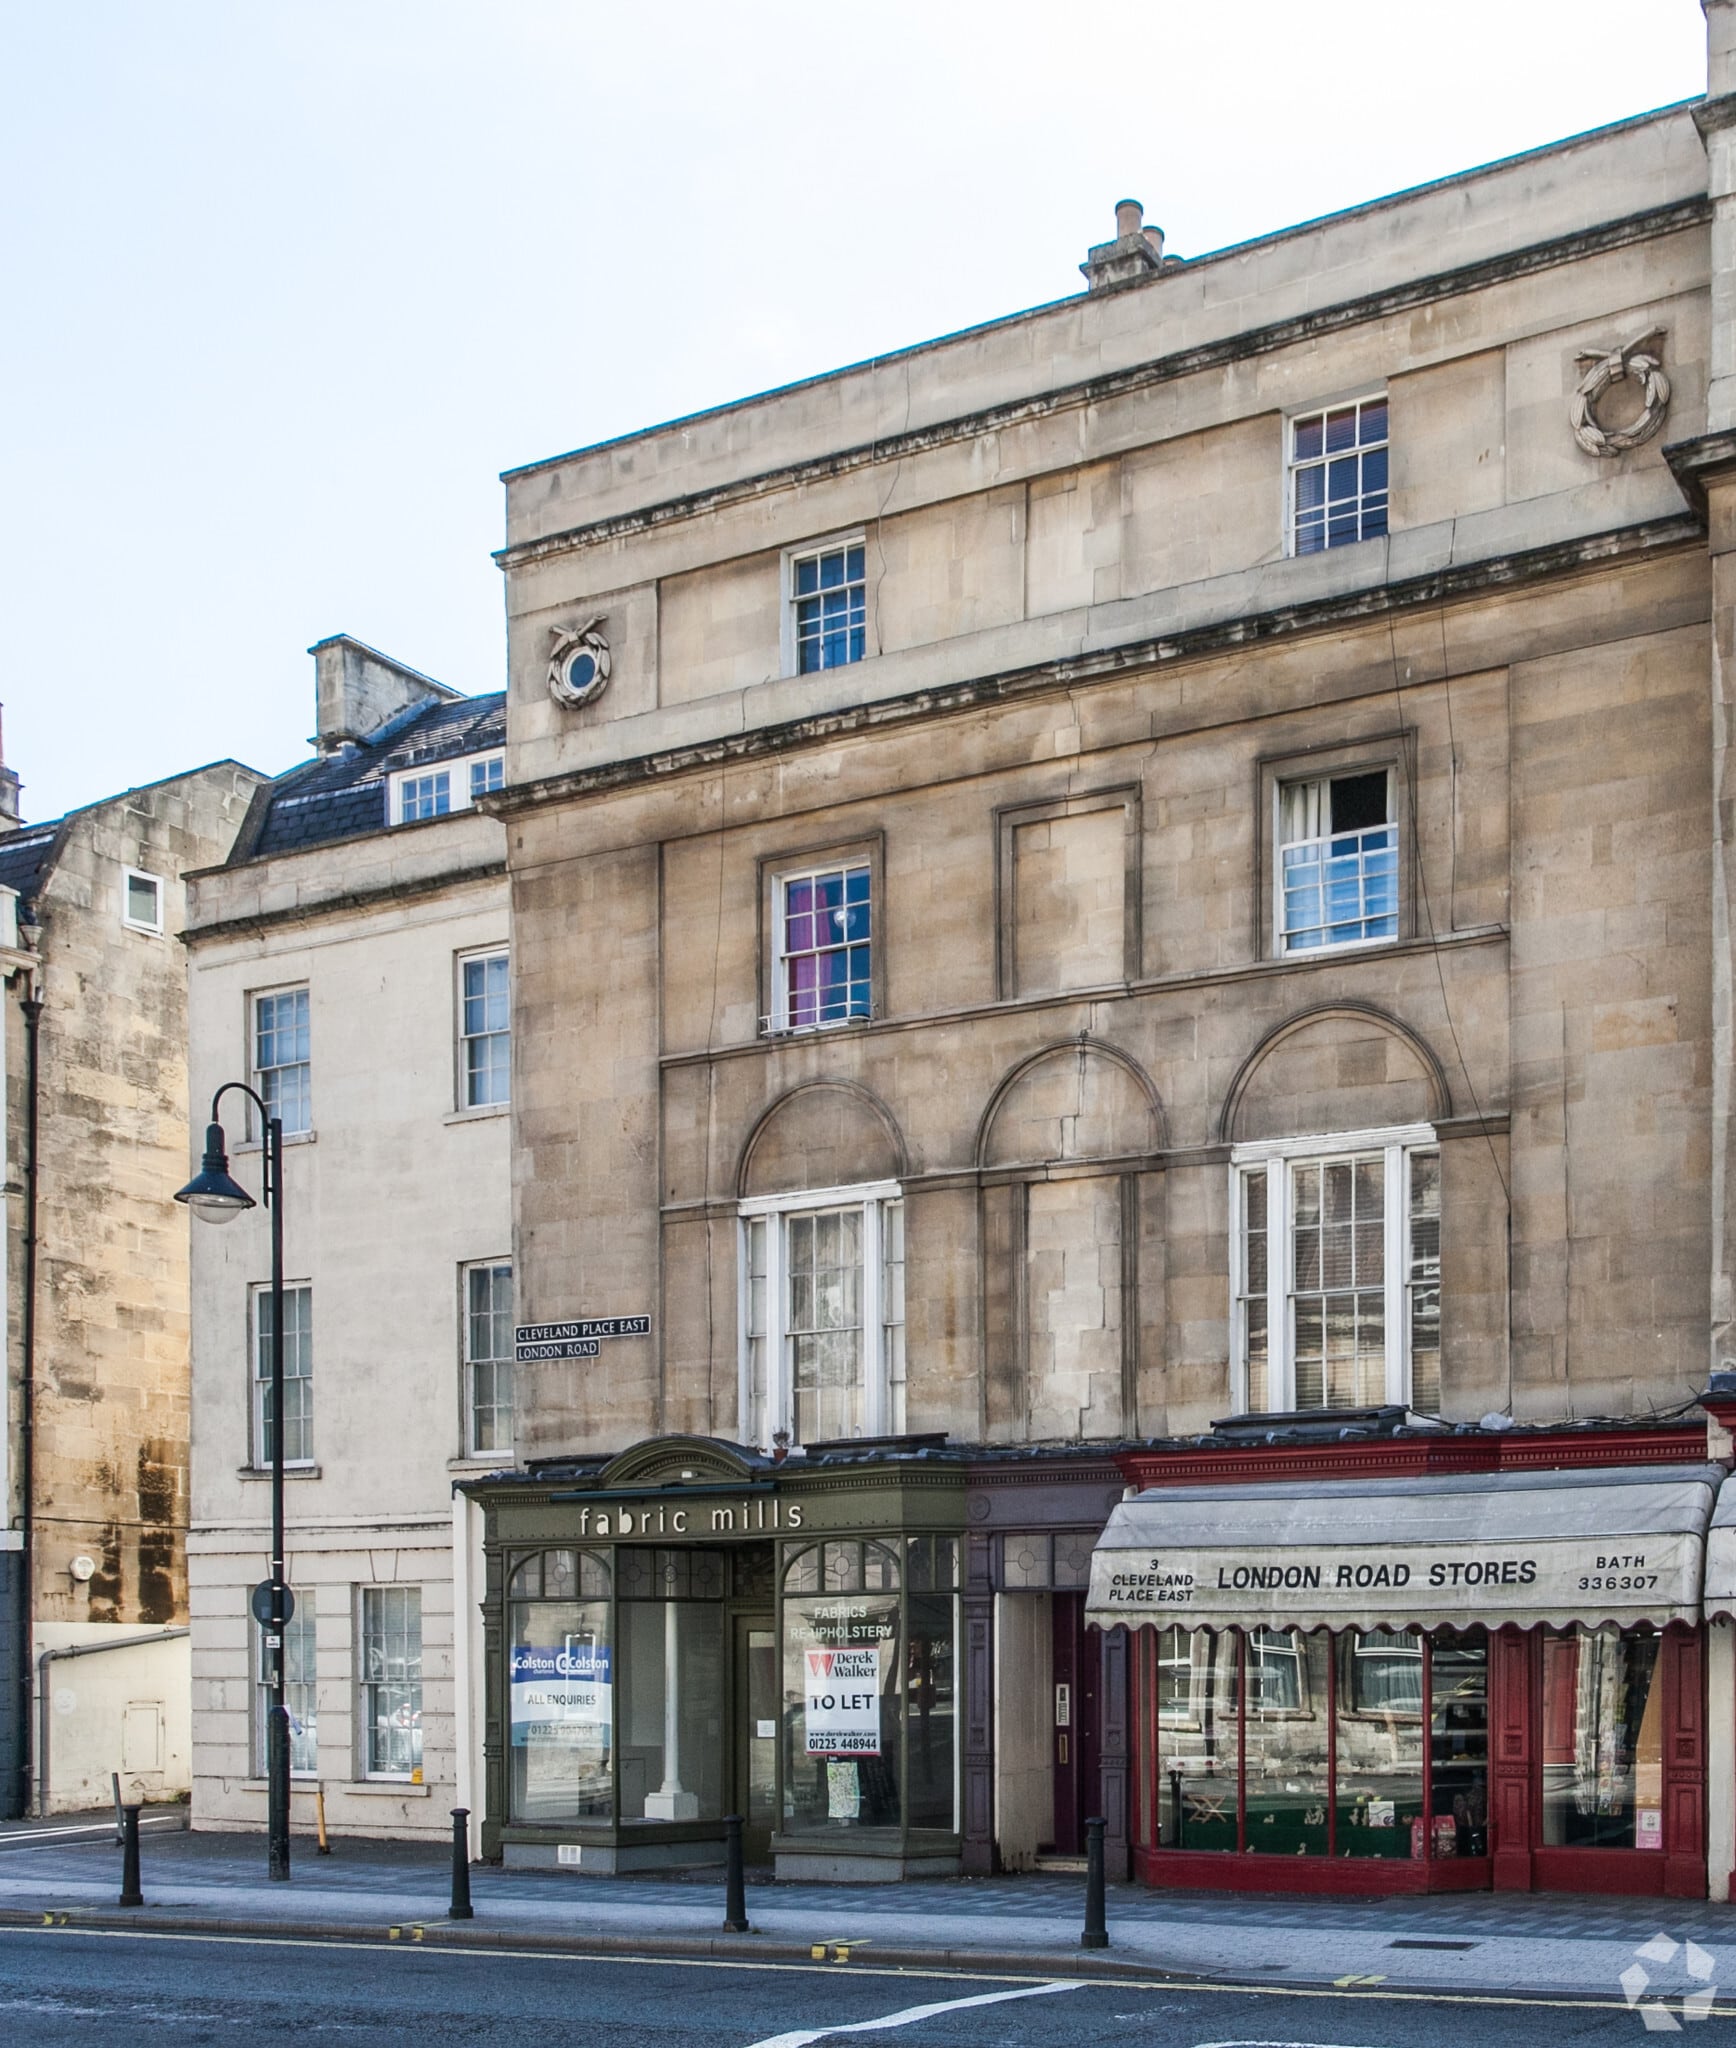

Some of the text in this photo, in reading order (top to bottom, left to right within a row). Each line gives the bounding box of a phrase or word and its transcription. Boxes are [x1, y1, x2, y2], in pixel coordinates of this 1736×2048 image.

[518, 1319, 645, 1341] CLEVELAND PLACE EAST
[518, 1342, 597, 1359] LONDON ROAD
[580, 1499, 802, 1535] fabric mills
[1150, 1559, 1159, 1570] 3
[1596, 1555, 1645, 1569] BATH
[1112, 1574, 1193, 1586] CLEVELAND
[1217, 1560, 1537, 1589] LONDON ROAD STORES
[1578, 1575, 1658, 1590] 336307
[1109, 1589, 1194, 1601] PLACE EAST
[814, 1606, 867, 1619] FABRICS
[790, 1625, 892, 1639] RE-UPHOLSTERY
[515, 1656, 555, 1669] Colston
[569, 1656, 609, 1669] Colston
[837, 1651, 873, 1664] Derek
[834, 1665, 876, 1678] Walker
[527, 1694, 596, 1705] ALL ENQUIRIES
[810, 1694, 874, 1710] TO LET
[531, 1725, 558, 1735] 01225
[809, 1738, 877, 1750] 01225 448944
